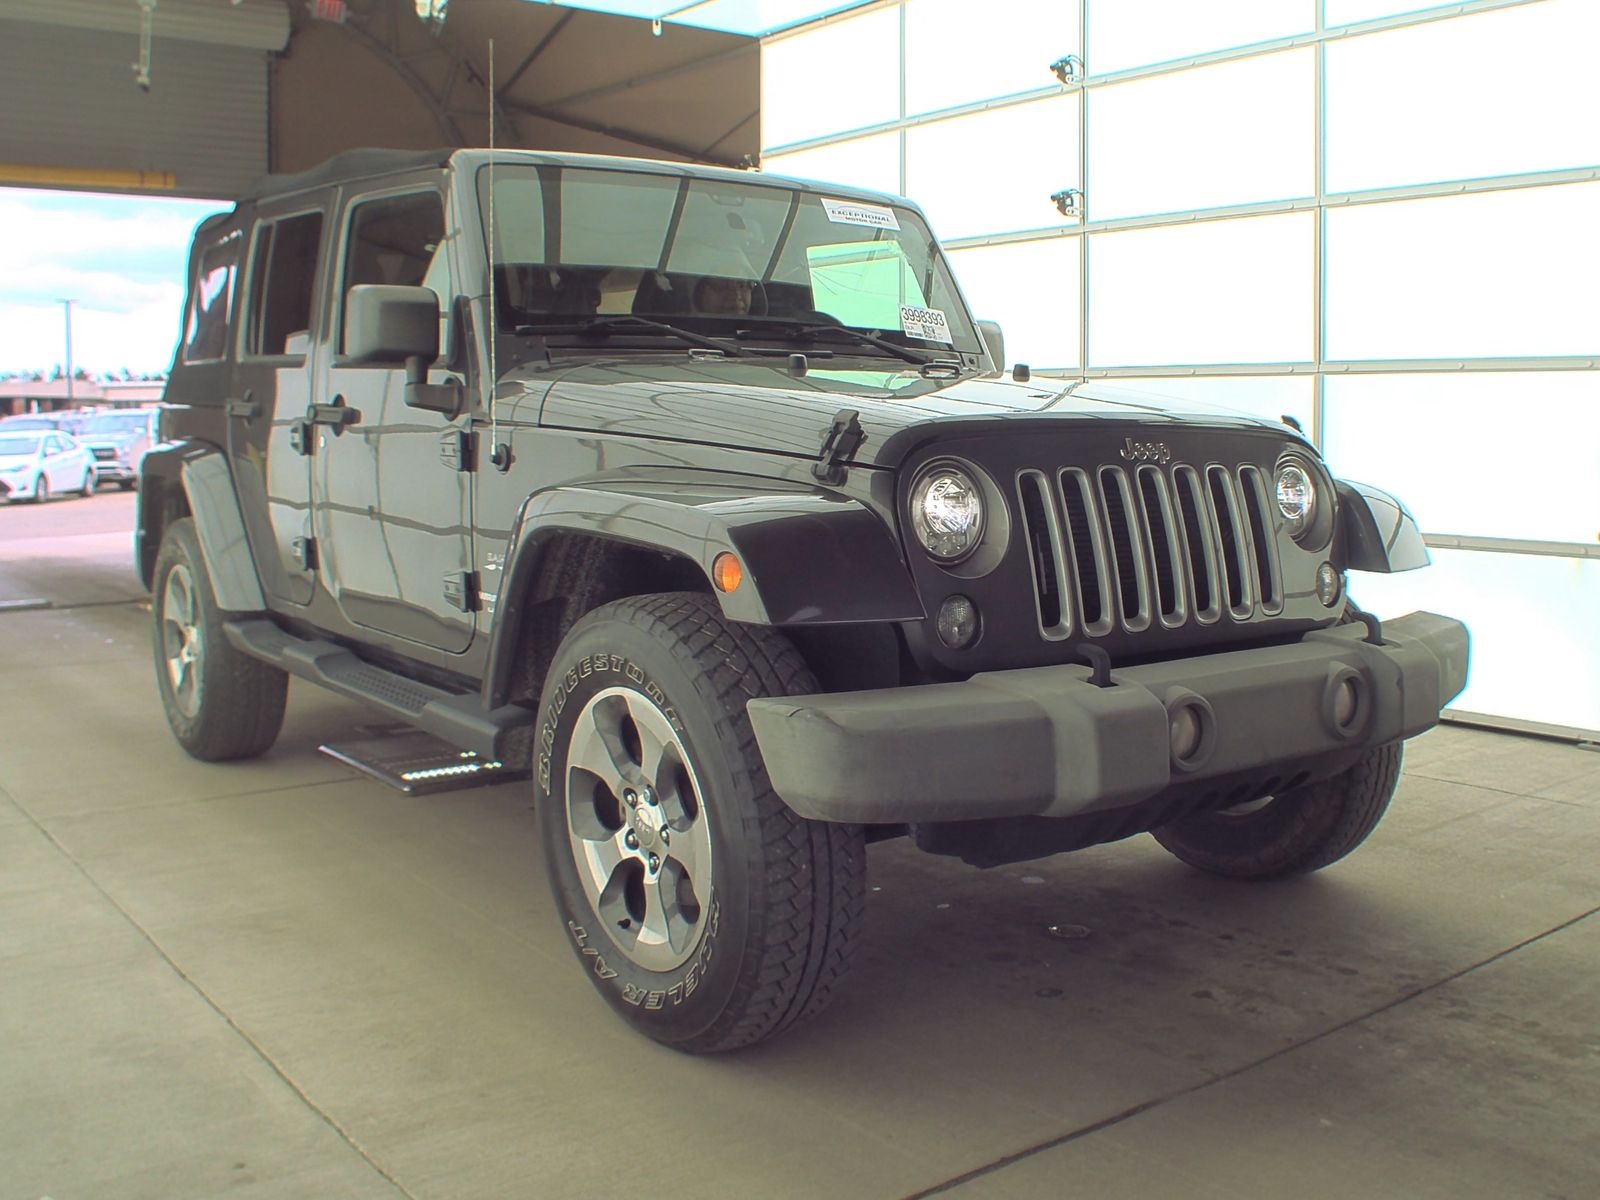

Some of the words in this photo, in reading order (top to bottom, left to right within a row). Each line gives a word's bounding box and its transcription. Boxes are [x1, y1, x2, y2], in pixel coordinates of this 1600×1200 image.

[831, 209, 889, 222] EXCEPTIONAL
[901, 307, 945, 326] 3998393
[1119, 437, 1170, 464] Jeep
[538, 653, 684, 797] BRIDGESTONE
